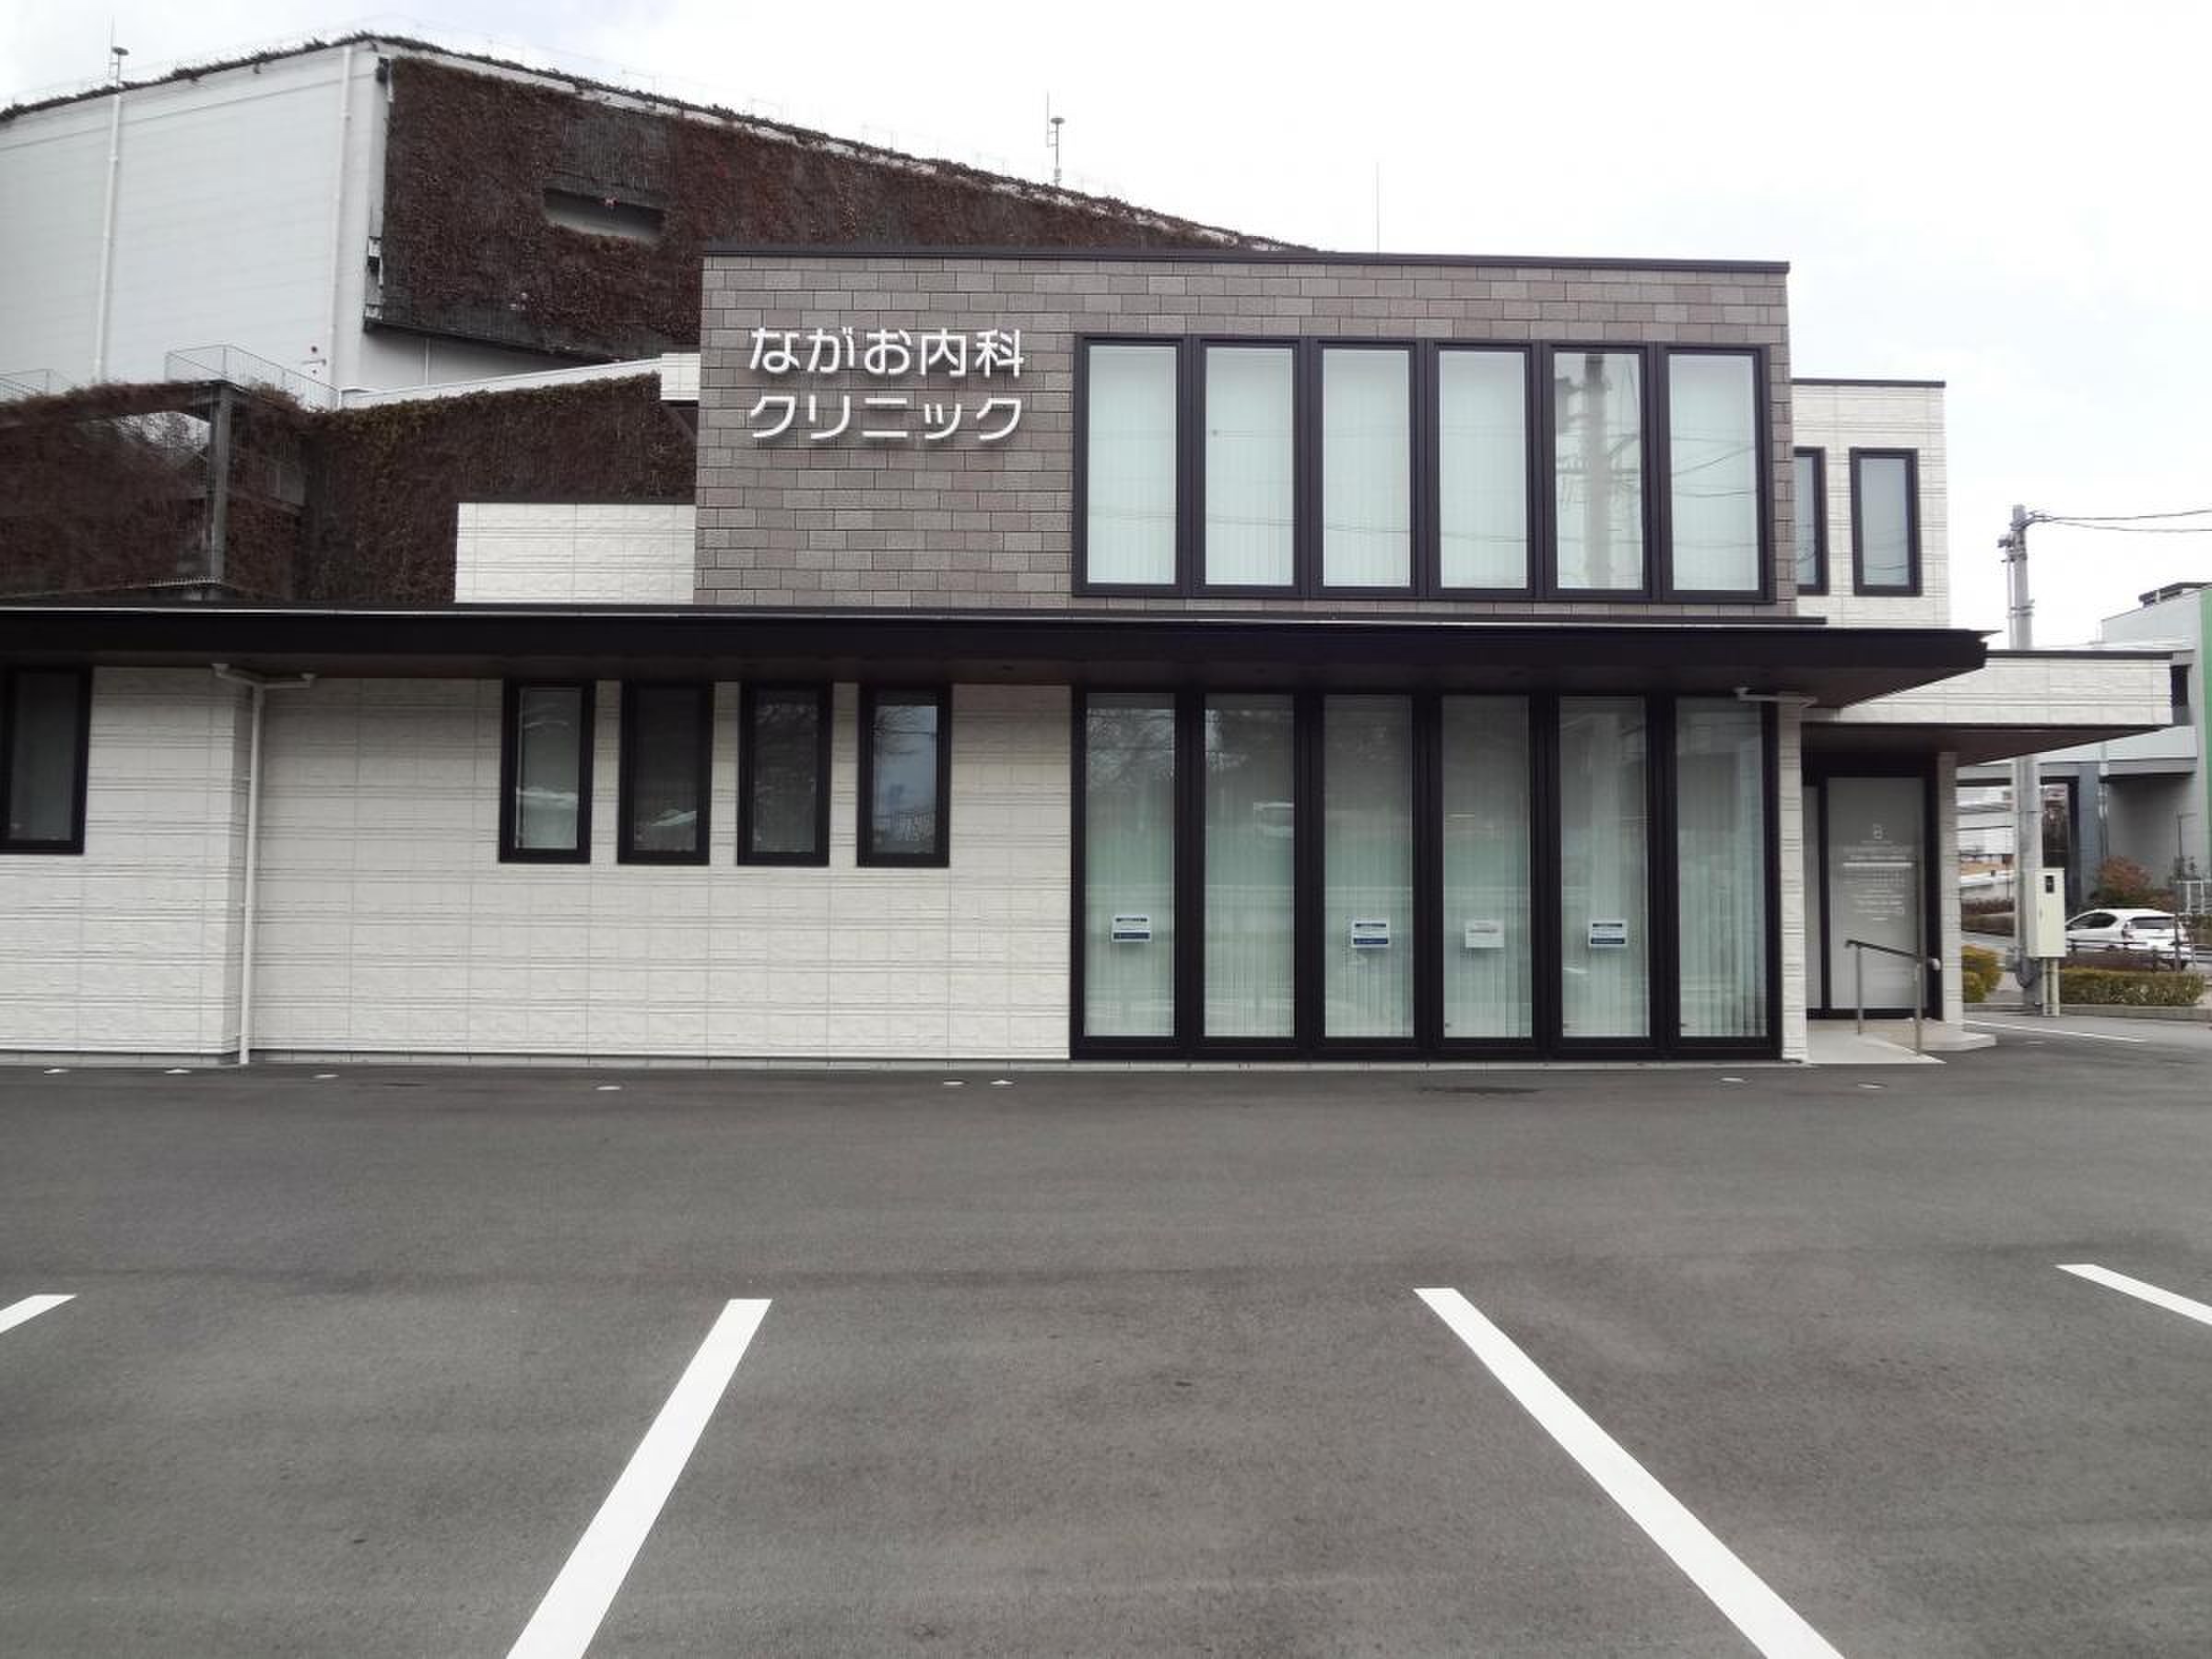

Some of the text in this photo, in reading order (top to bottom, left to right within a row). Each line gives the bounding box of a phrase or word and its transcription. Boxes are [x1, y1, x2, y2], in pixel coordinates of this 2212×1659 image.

[748, 326, 1025, 378] ながお内科
[749, 394, 1023, 441] クリニック
